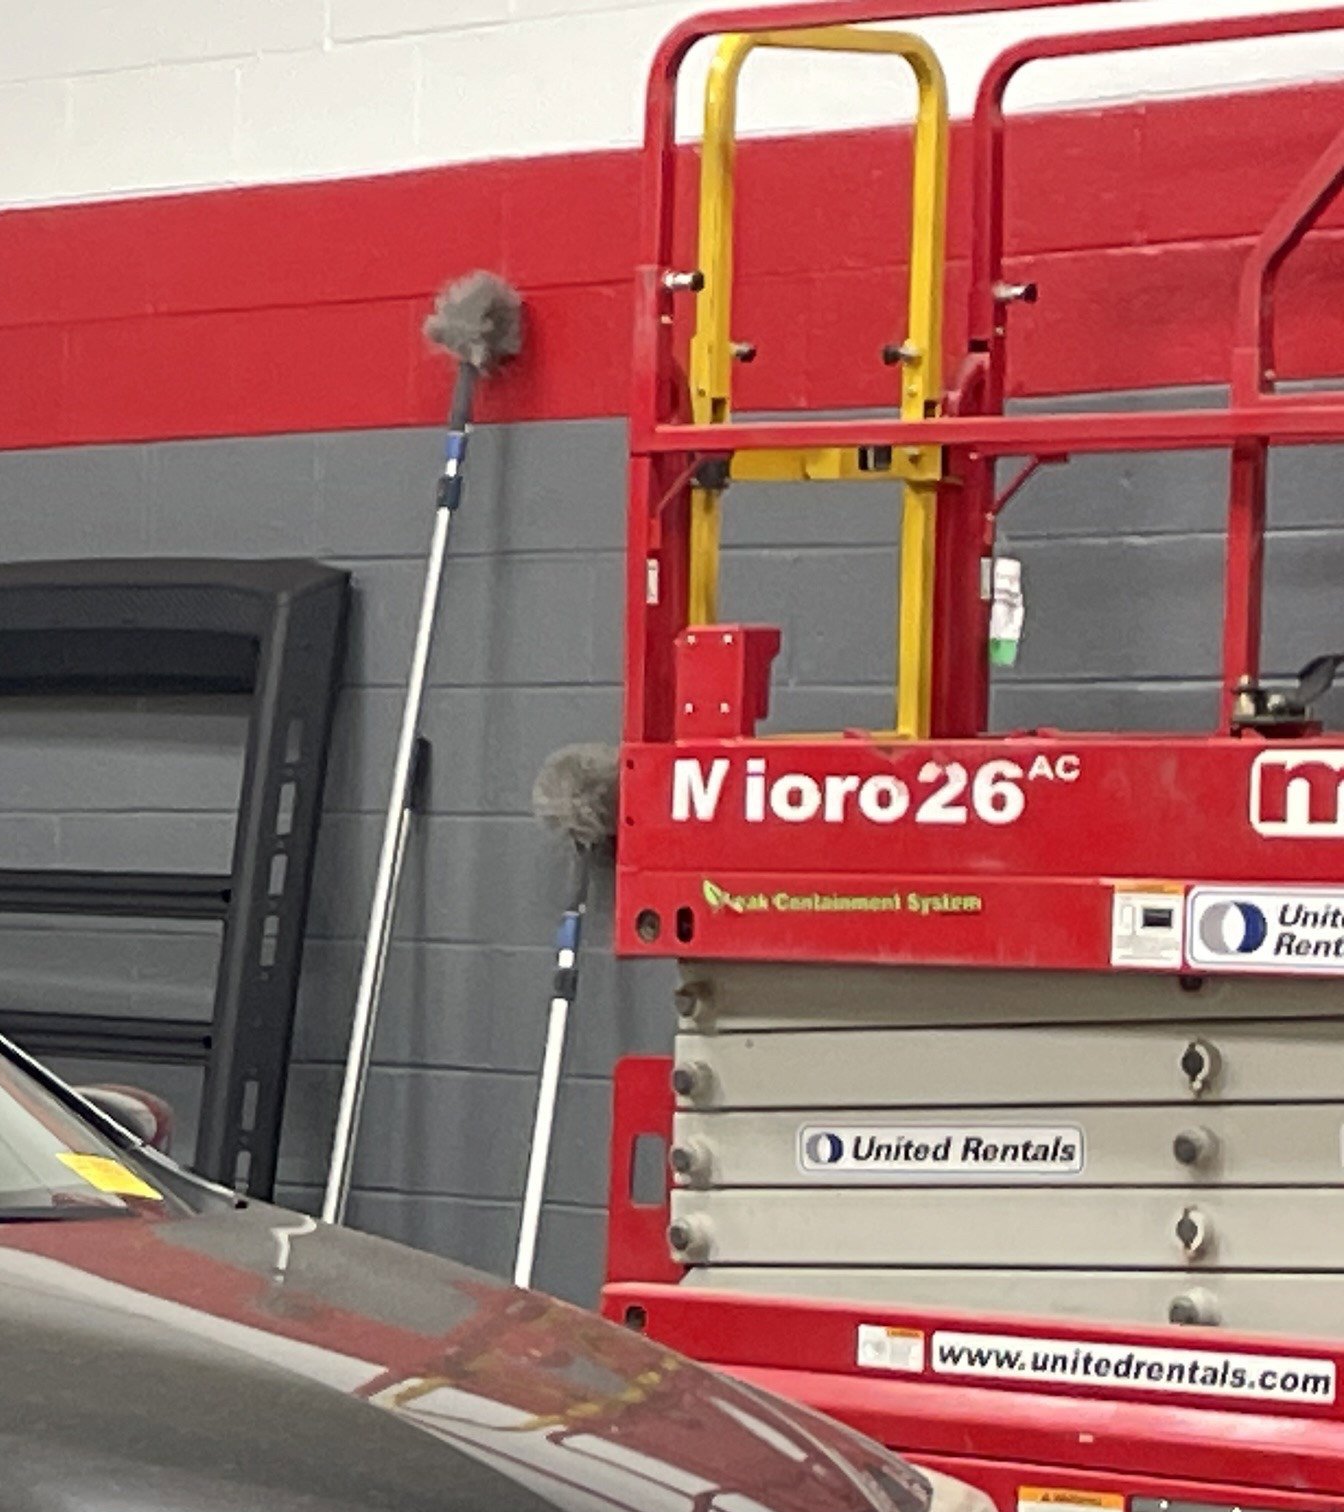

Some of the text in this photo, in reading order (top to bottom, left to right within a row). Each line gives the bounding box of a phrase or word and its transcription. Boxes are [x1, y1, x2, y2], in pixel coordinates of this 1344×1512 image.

[1027, 754, 1081, 782] AC
[773, 892, 900, 911] Containment
[907, 892, 982, 916] System
[1278, 903, 1344, 928] Unit
[852, 1136, 1077, 1163] United Rentals
[938, 1343, 1332, 1396] www.unitedrentals.com
